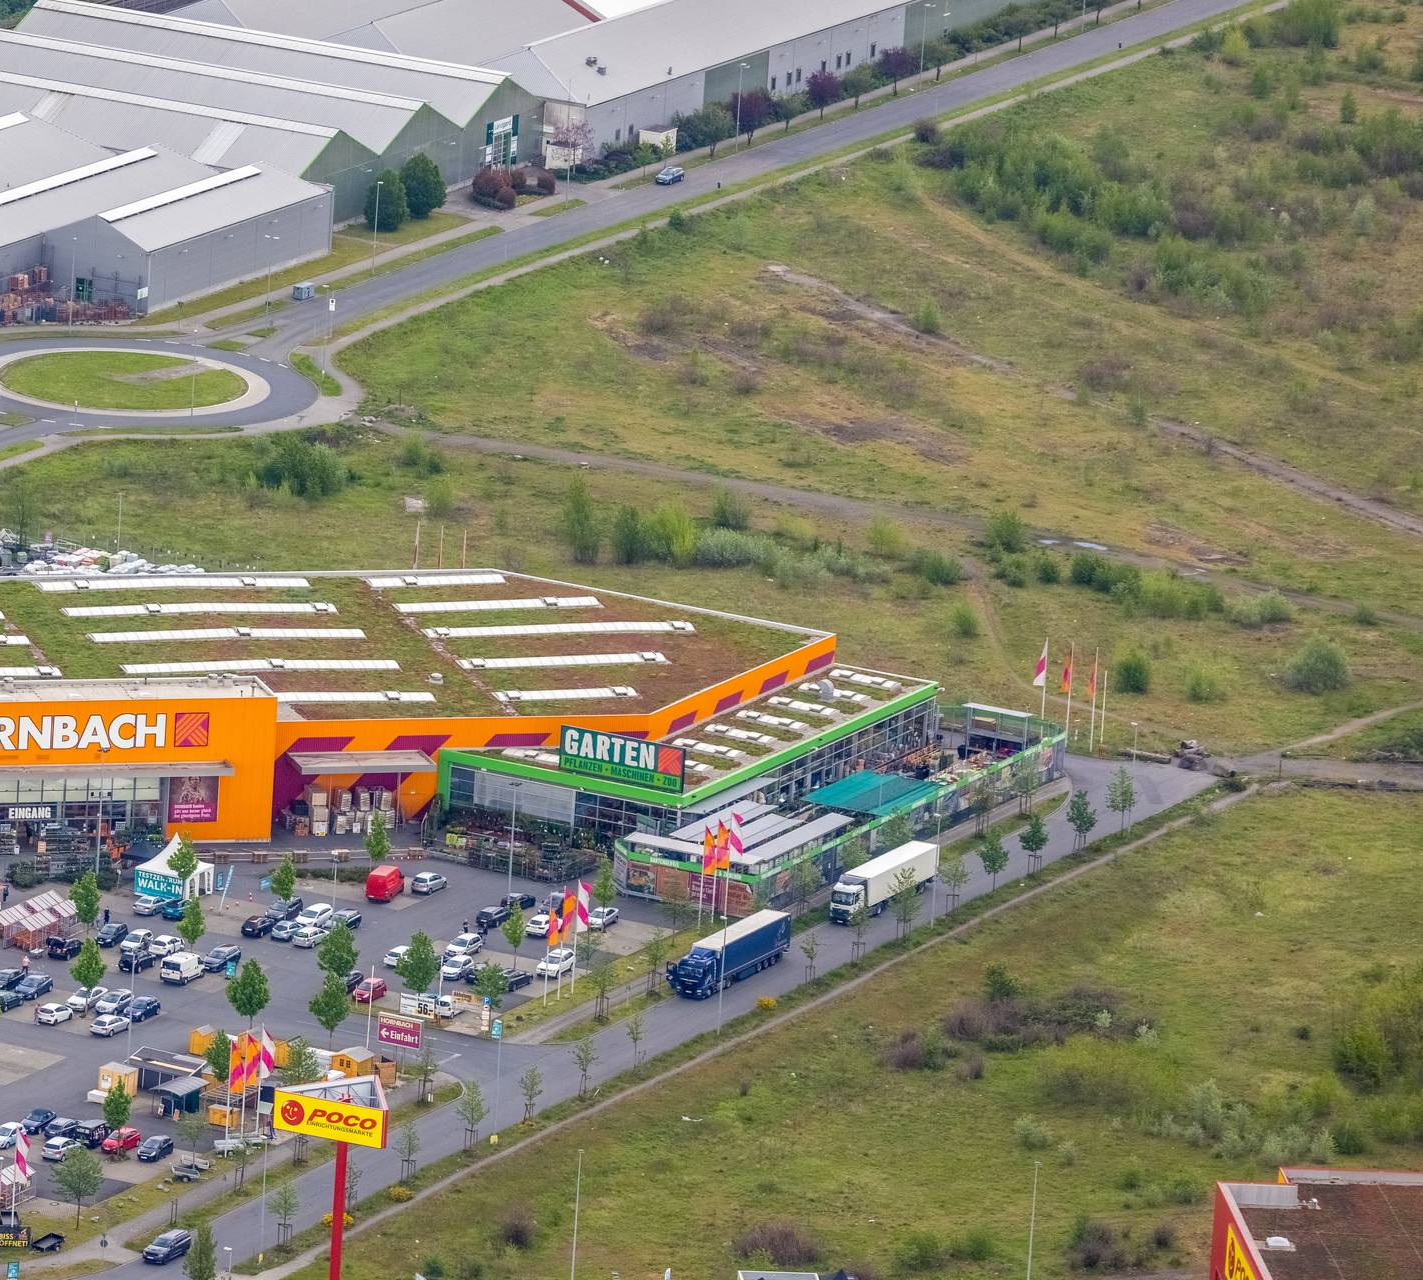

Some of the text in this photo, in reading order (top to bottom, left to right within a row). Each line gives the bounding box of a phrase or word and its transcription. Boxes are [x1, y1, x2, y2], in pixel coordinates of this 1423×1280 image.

[564, 728, 656, 770] GARTEN
[563, 757, 678, 788] PFLANZEN MASCHINEN ZOO
[8, 807, 51, 819] EINGANG
[138, 877, 183, 895] WALK-IN
[380, 1016, 413, 1029] HORNBACH
[390, 1030, 419, 1044] Einfahrt
[307, 1108, 377, 1130] POCO
